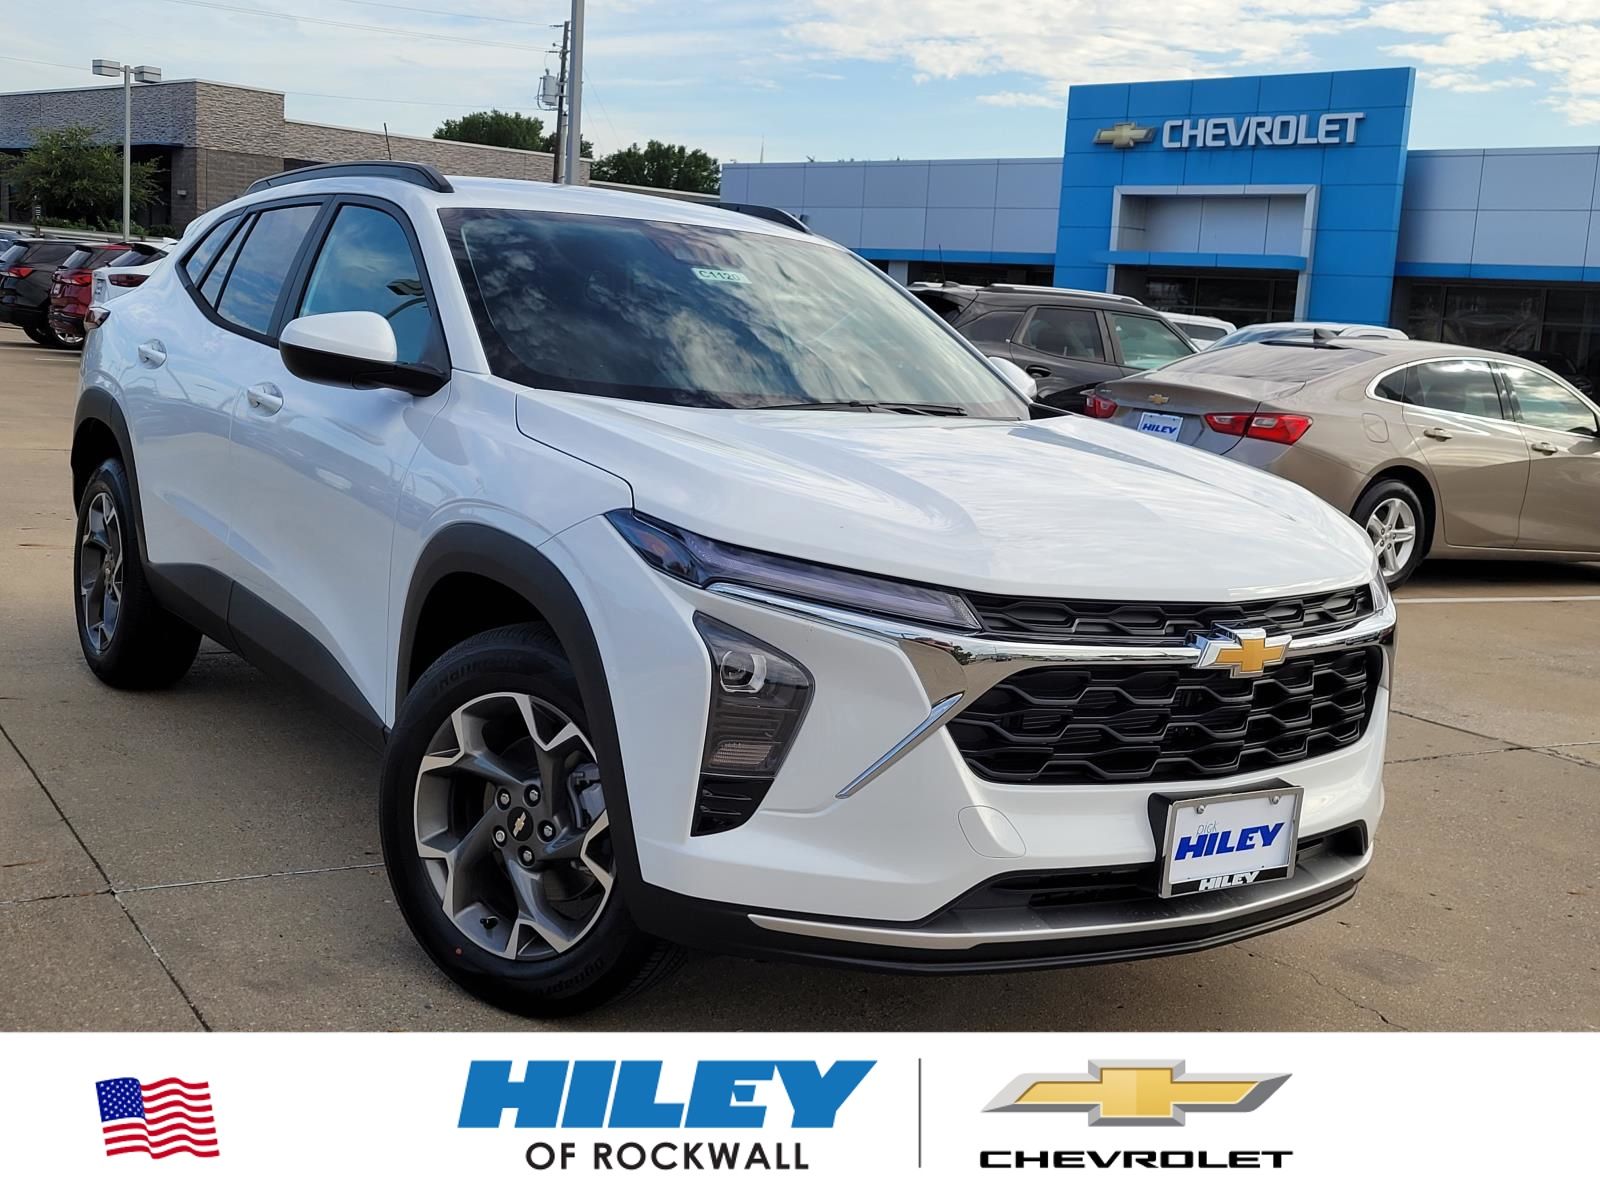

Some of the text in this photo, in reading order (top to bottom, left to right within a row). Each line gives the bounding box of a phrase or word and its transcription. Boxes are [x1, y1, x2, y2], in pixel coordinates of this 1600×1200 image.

[1162, 112, 1365, 149] CHEVROLET
[1142, 423, 1177, 434] HILEY
[1174, 822, 1285, 861] HILEY
[1199, 871, 1260, 891] HILEY
